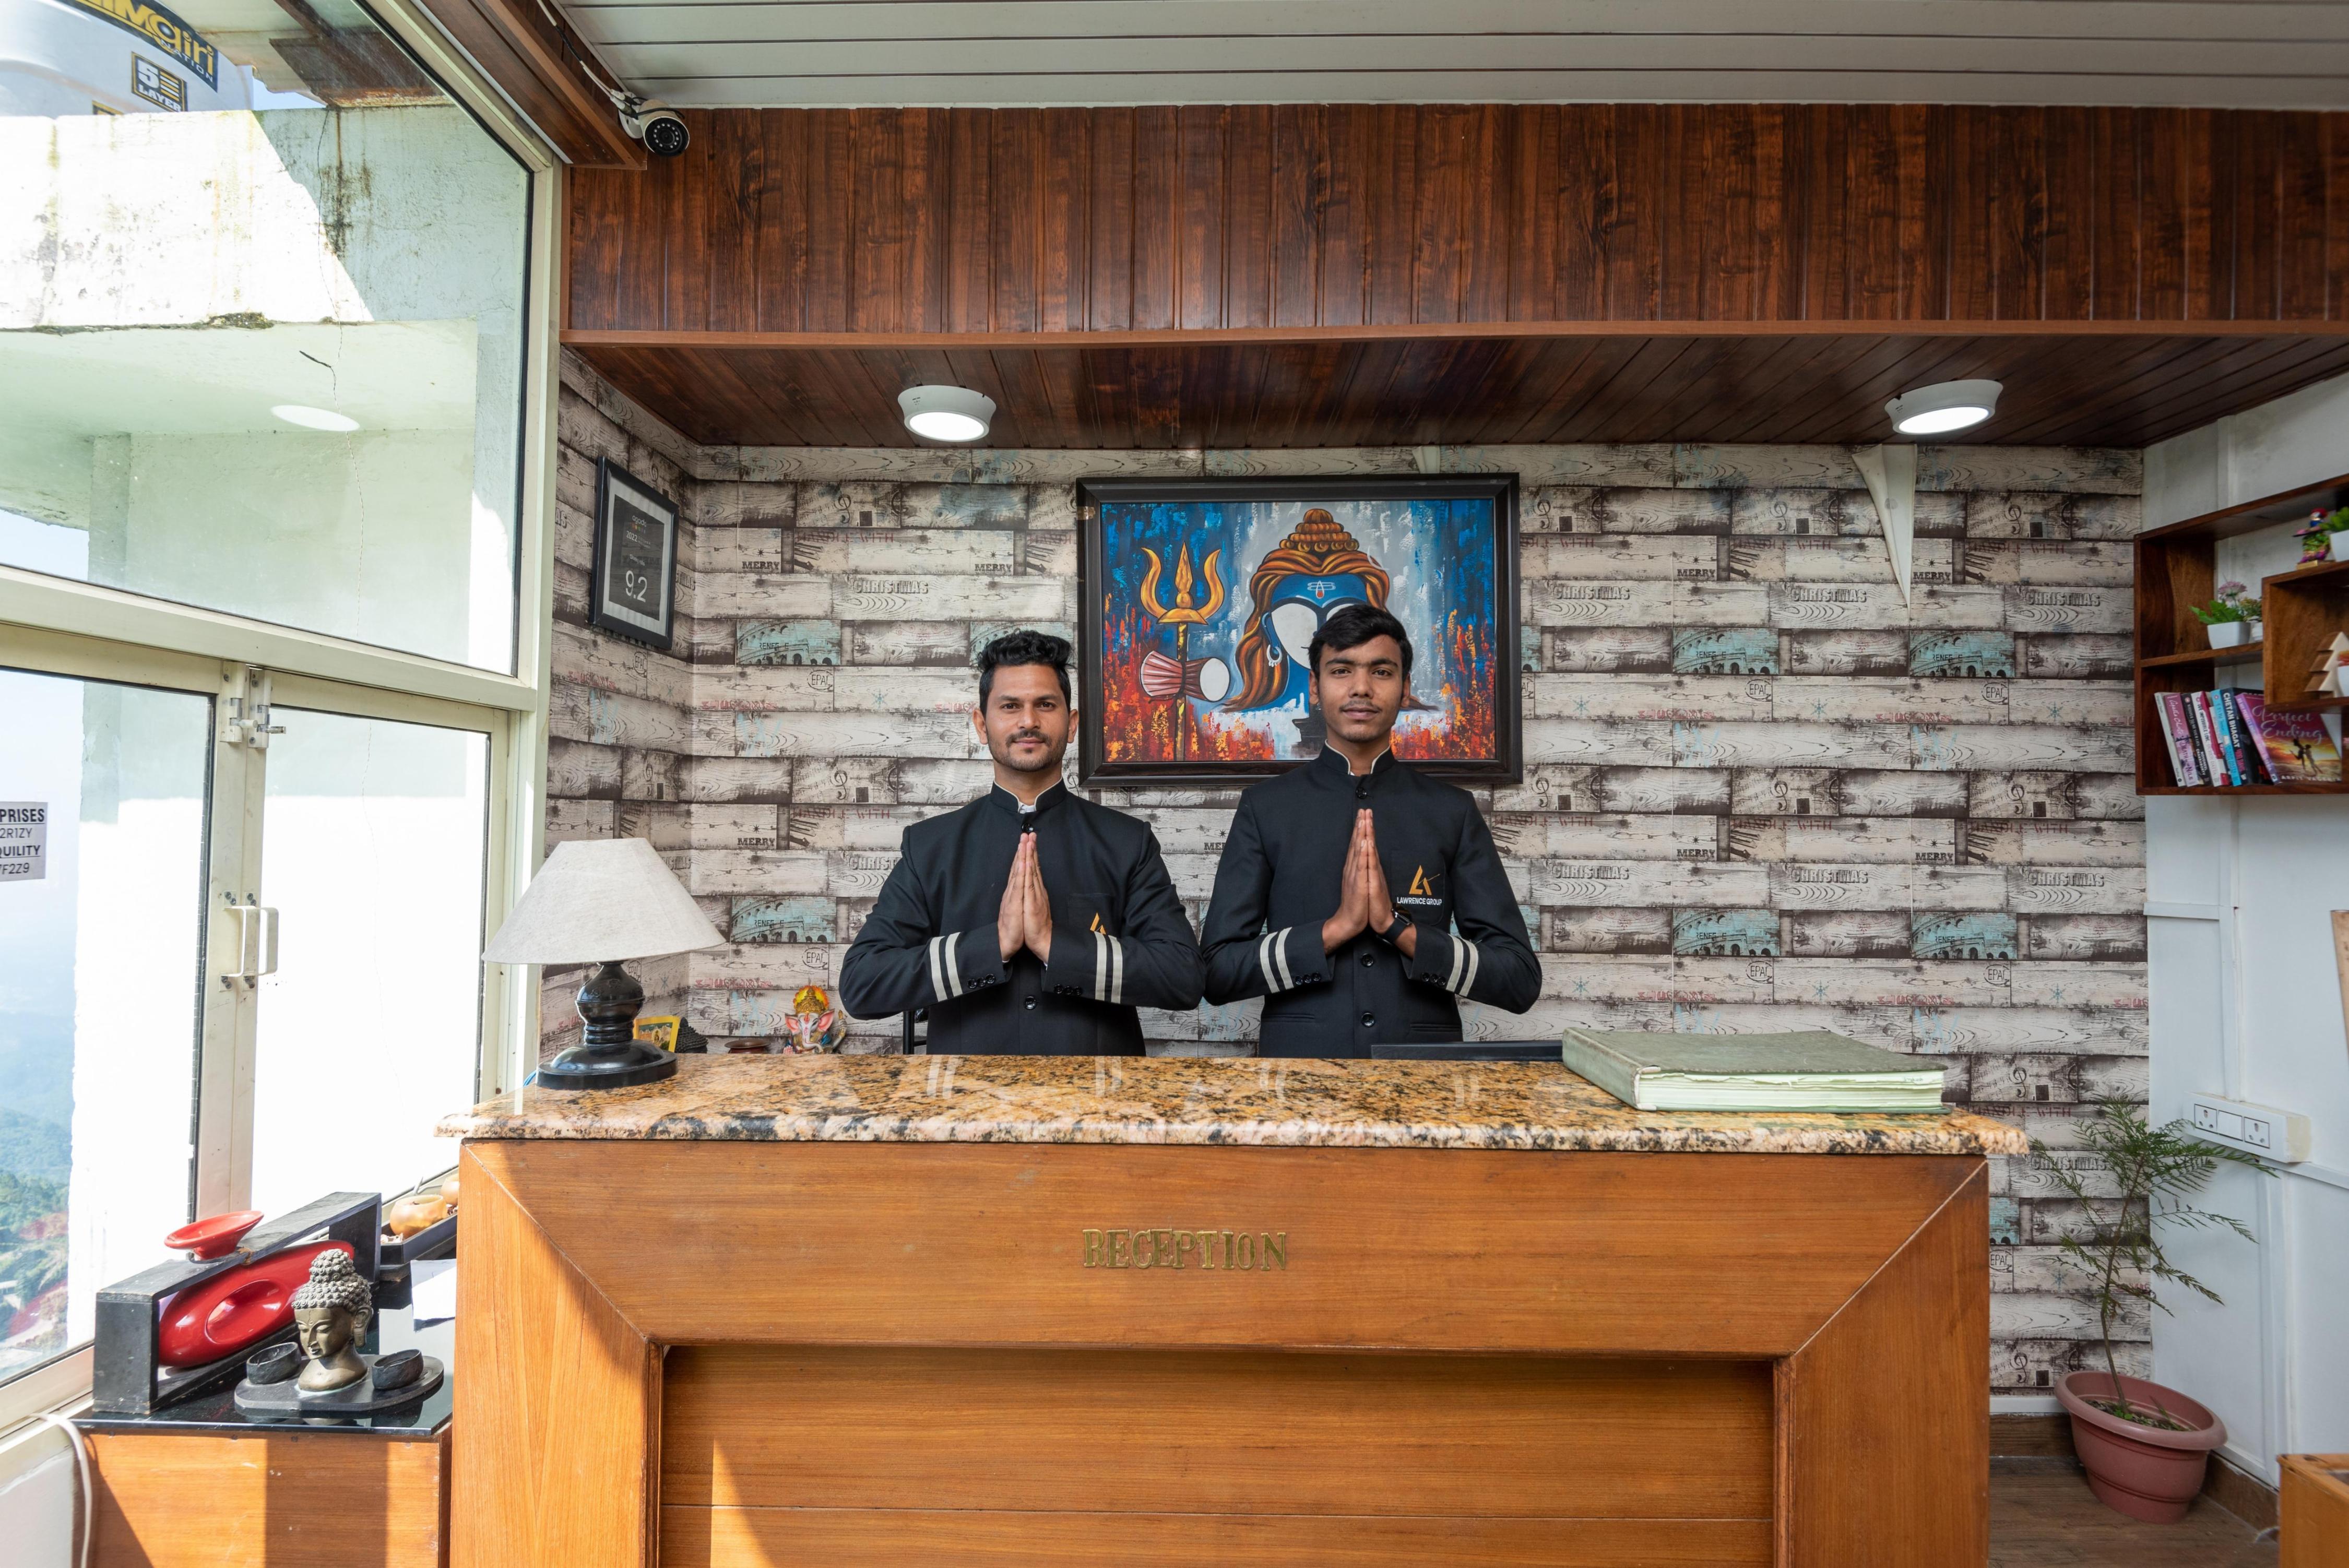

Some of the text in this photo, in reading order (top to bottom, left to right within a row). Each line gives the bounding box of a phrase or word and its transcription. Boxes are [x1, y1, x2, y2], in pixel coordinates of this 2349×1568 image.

[138, 83, 182, 112] LAYER
[626, 530, 638, 542] 2022
[742, 562, 780, 570] MERRY
[975, 564, 1012, 572] MERRY
[1677, 568, 1716, 577] MERRY
[1913, 572, 1951, 580] MERRY
[626, 570, 647, 603] 9.2
[853, 580, 929, 594] CHRISTMAS
[1553, 586, 1630, 600] CHRISTMAS
[1790, 588, 1867, 602] CHRISTMAS
[2025, 591, 2101, 606] CHRISTMAS
[2223, 692, 2235, 719] CHETAN
[2228, 720, 2240, 748] BHAGAT
[2261, 720, 2324, 745] Ending
[738, 837, 775, 846] MERRY
[0, 845, 41, 857] UILITY
[1677, 849, 1715, 858] MERRY
[1915, 852, 1953, 862] MERRY
[1552, 865, 1629, 879] CHRISTMAS
[1791, 869, 1868, 883] CHRISTMAS
[2028, 873, 2105, 887] CHRISTMAS
[1082, 1229, 1286, 1270] RECEPTION
